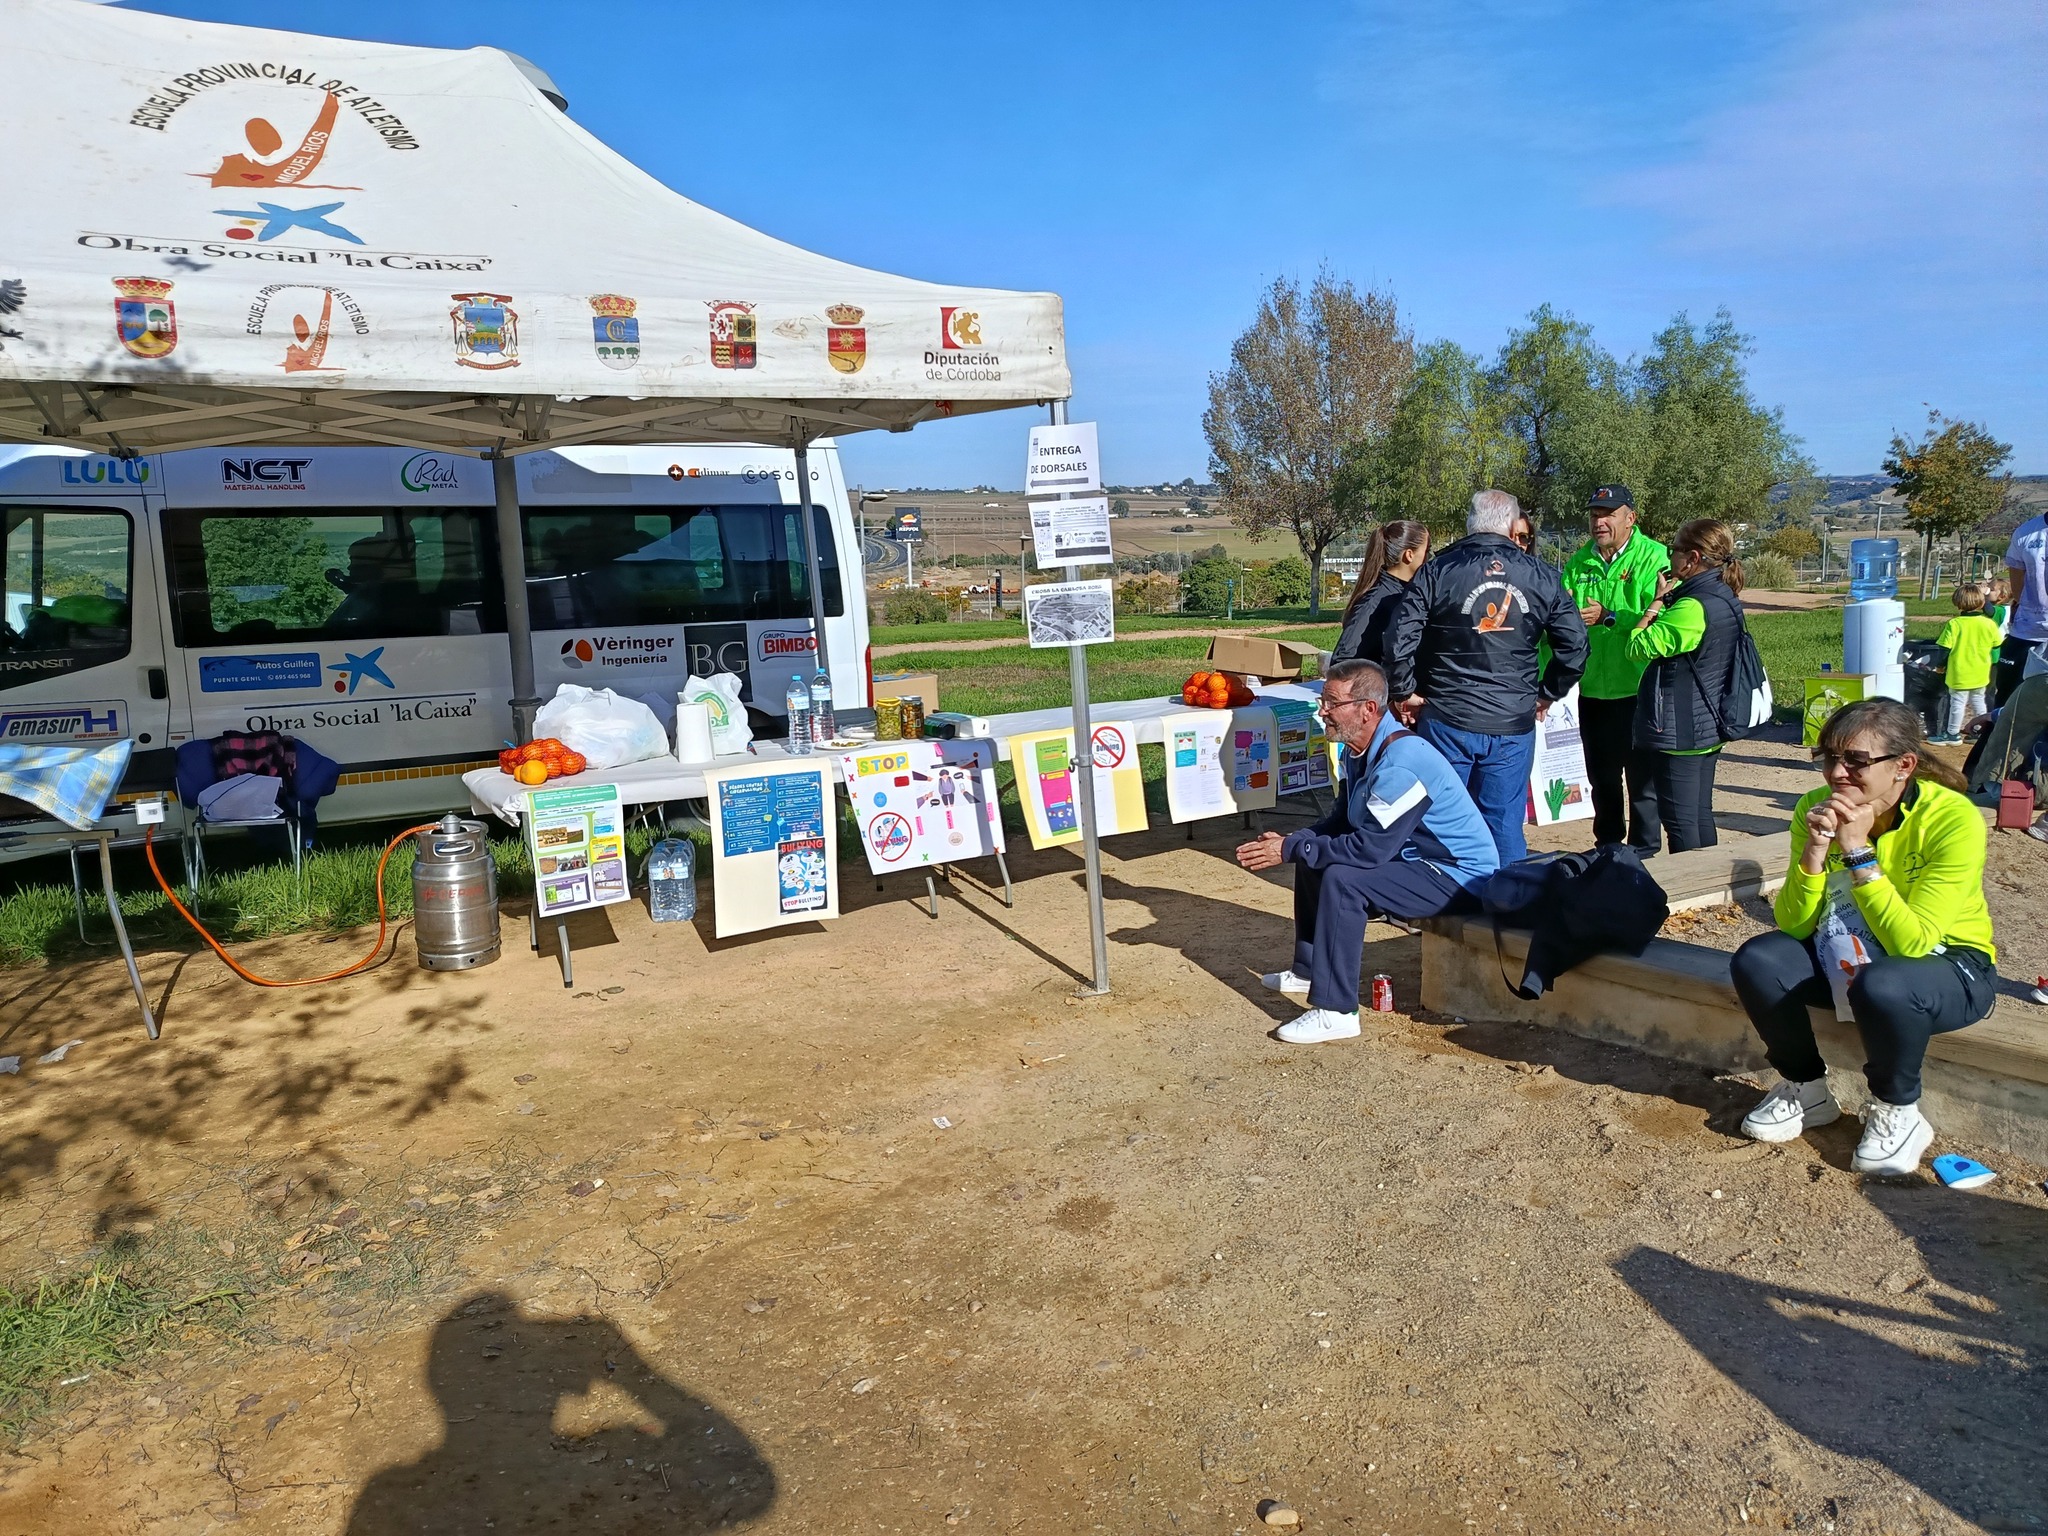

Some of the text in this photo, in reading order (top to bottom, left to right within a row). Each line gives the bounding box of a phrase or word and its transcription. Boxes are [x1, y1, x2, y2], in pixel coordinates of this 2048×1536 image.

[129, 62, 420, 151] ESCUELA PROVINCIAL DE ATLETISMO
[275, 130, 329, 184] MIGUEL RIOS
[77, 234, 189, 256] Obra
[202, 243, 318, 266] Social
[246, 296, 270, 336] ESCUELA
[333, 291, 370, 335] ATLETISMO
[309, 319, 329, 367] MIGUEL RIOS
[924, 351, 999, 367] Diputación
[926, 368, 1001, 381] de Córdoba
[1040, 445, 1081, 456] ENTREGA
[65, 455, 149, 484] LULÚ
[221, 458, 314, 483] NCT
[415, 457, 458, 484] Rad
[746, 469, 819, 481] cosao
[1030, 462, 1087, 474] DE DORSALES
[592, 634, 674, 651] Vèringer
[764, 636, 818, 654] BIMBO
[0, 658, 74, 671] TRANSIT
[255, 659, 315, 670] Autos Guillén
[602, 654, 667, 667] Ingeniería
[688, 641, 748, 677] BG
[246, 715, 306, 733] Obra
[313, 707, 380, 728] Social
[860, 756, 906, 774] STOP
[781, 839, 823, 854] BULLYING
[1826, 889, 1842, 900] Cross
[784, 900, 798, 908] STOP
